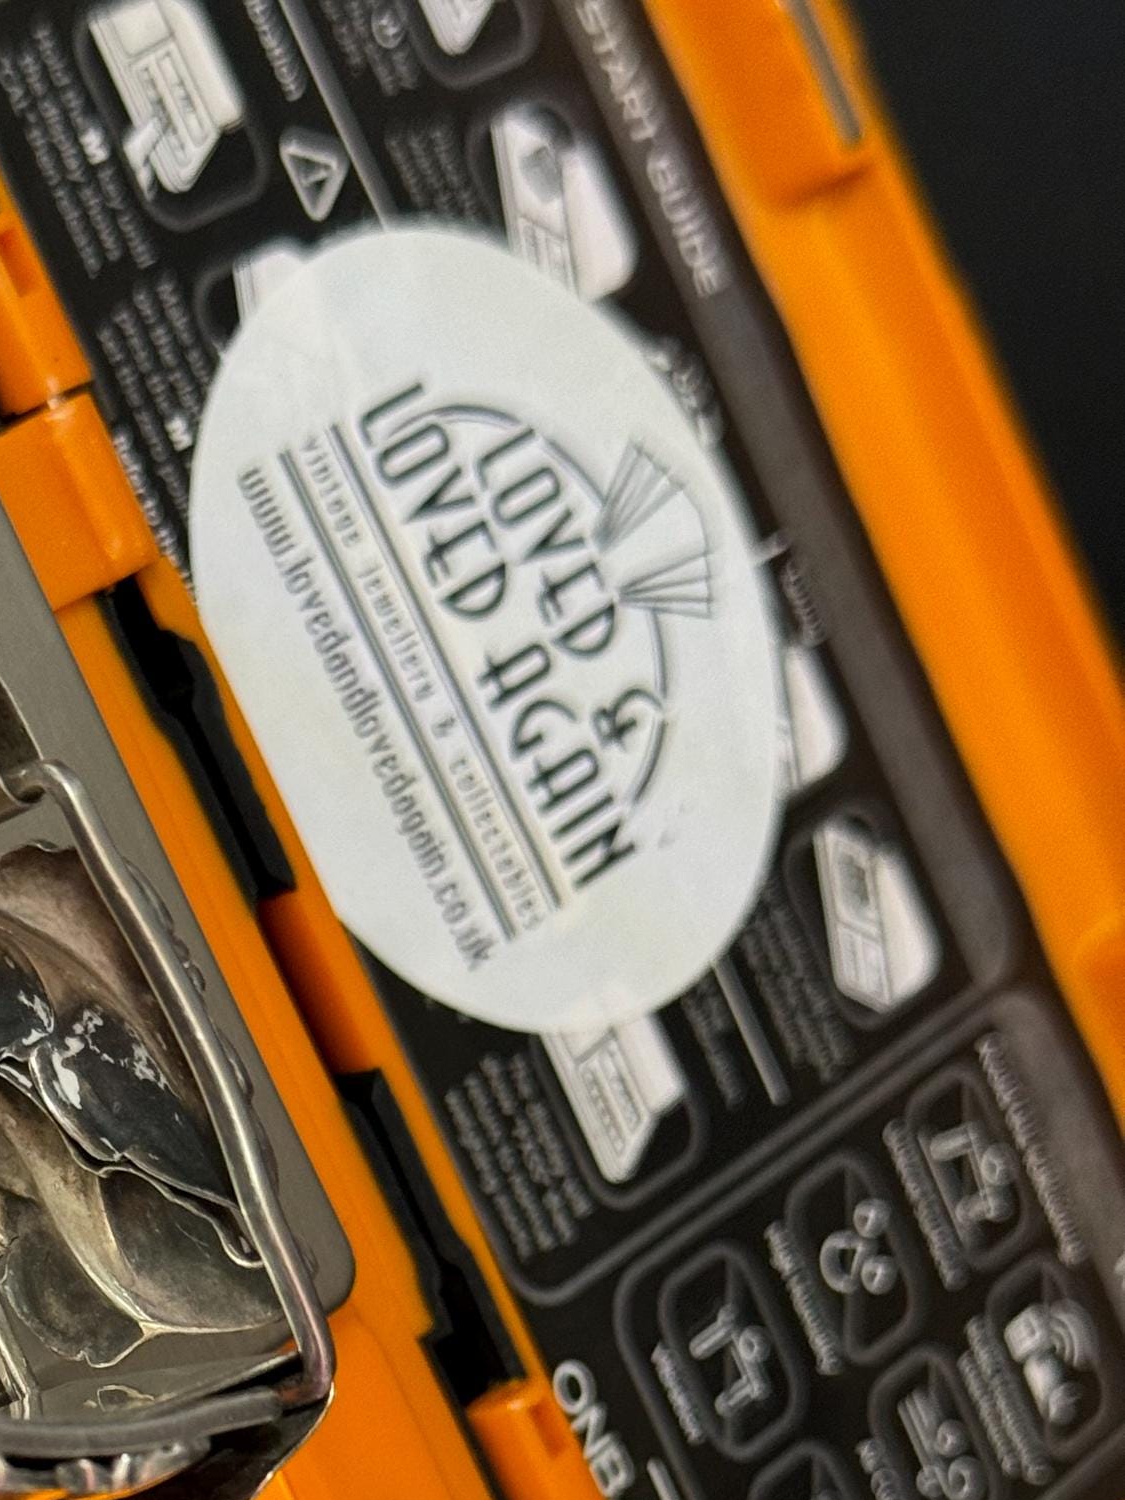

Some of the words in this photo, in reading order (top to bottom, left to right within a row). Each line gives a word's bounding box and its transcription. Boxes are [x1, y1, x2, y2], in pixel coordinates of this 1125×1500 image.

[577, 0, 660, 142] START
[644, 152, 730, 299] GUIDE
[237, 465, 496, 973] www.lovedandlovedagain.co.uk
[302, 435, 363, 546] vintage
[356, 560, 439, 703] jewellery
[448, 749, 545, 931] collectables
[358, 382, 509, 622] LOVED
[477, 642, 636, 889] AGAIN
[475, 427, 620, 659] LOVED
[592, 687, 662, 752] &
